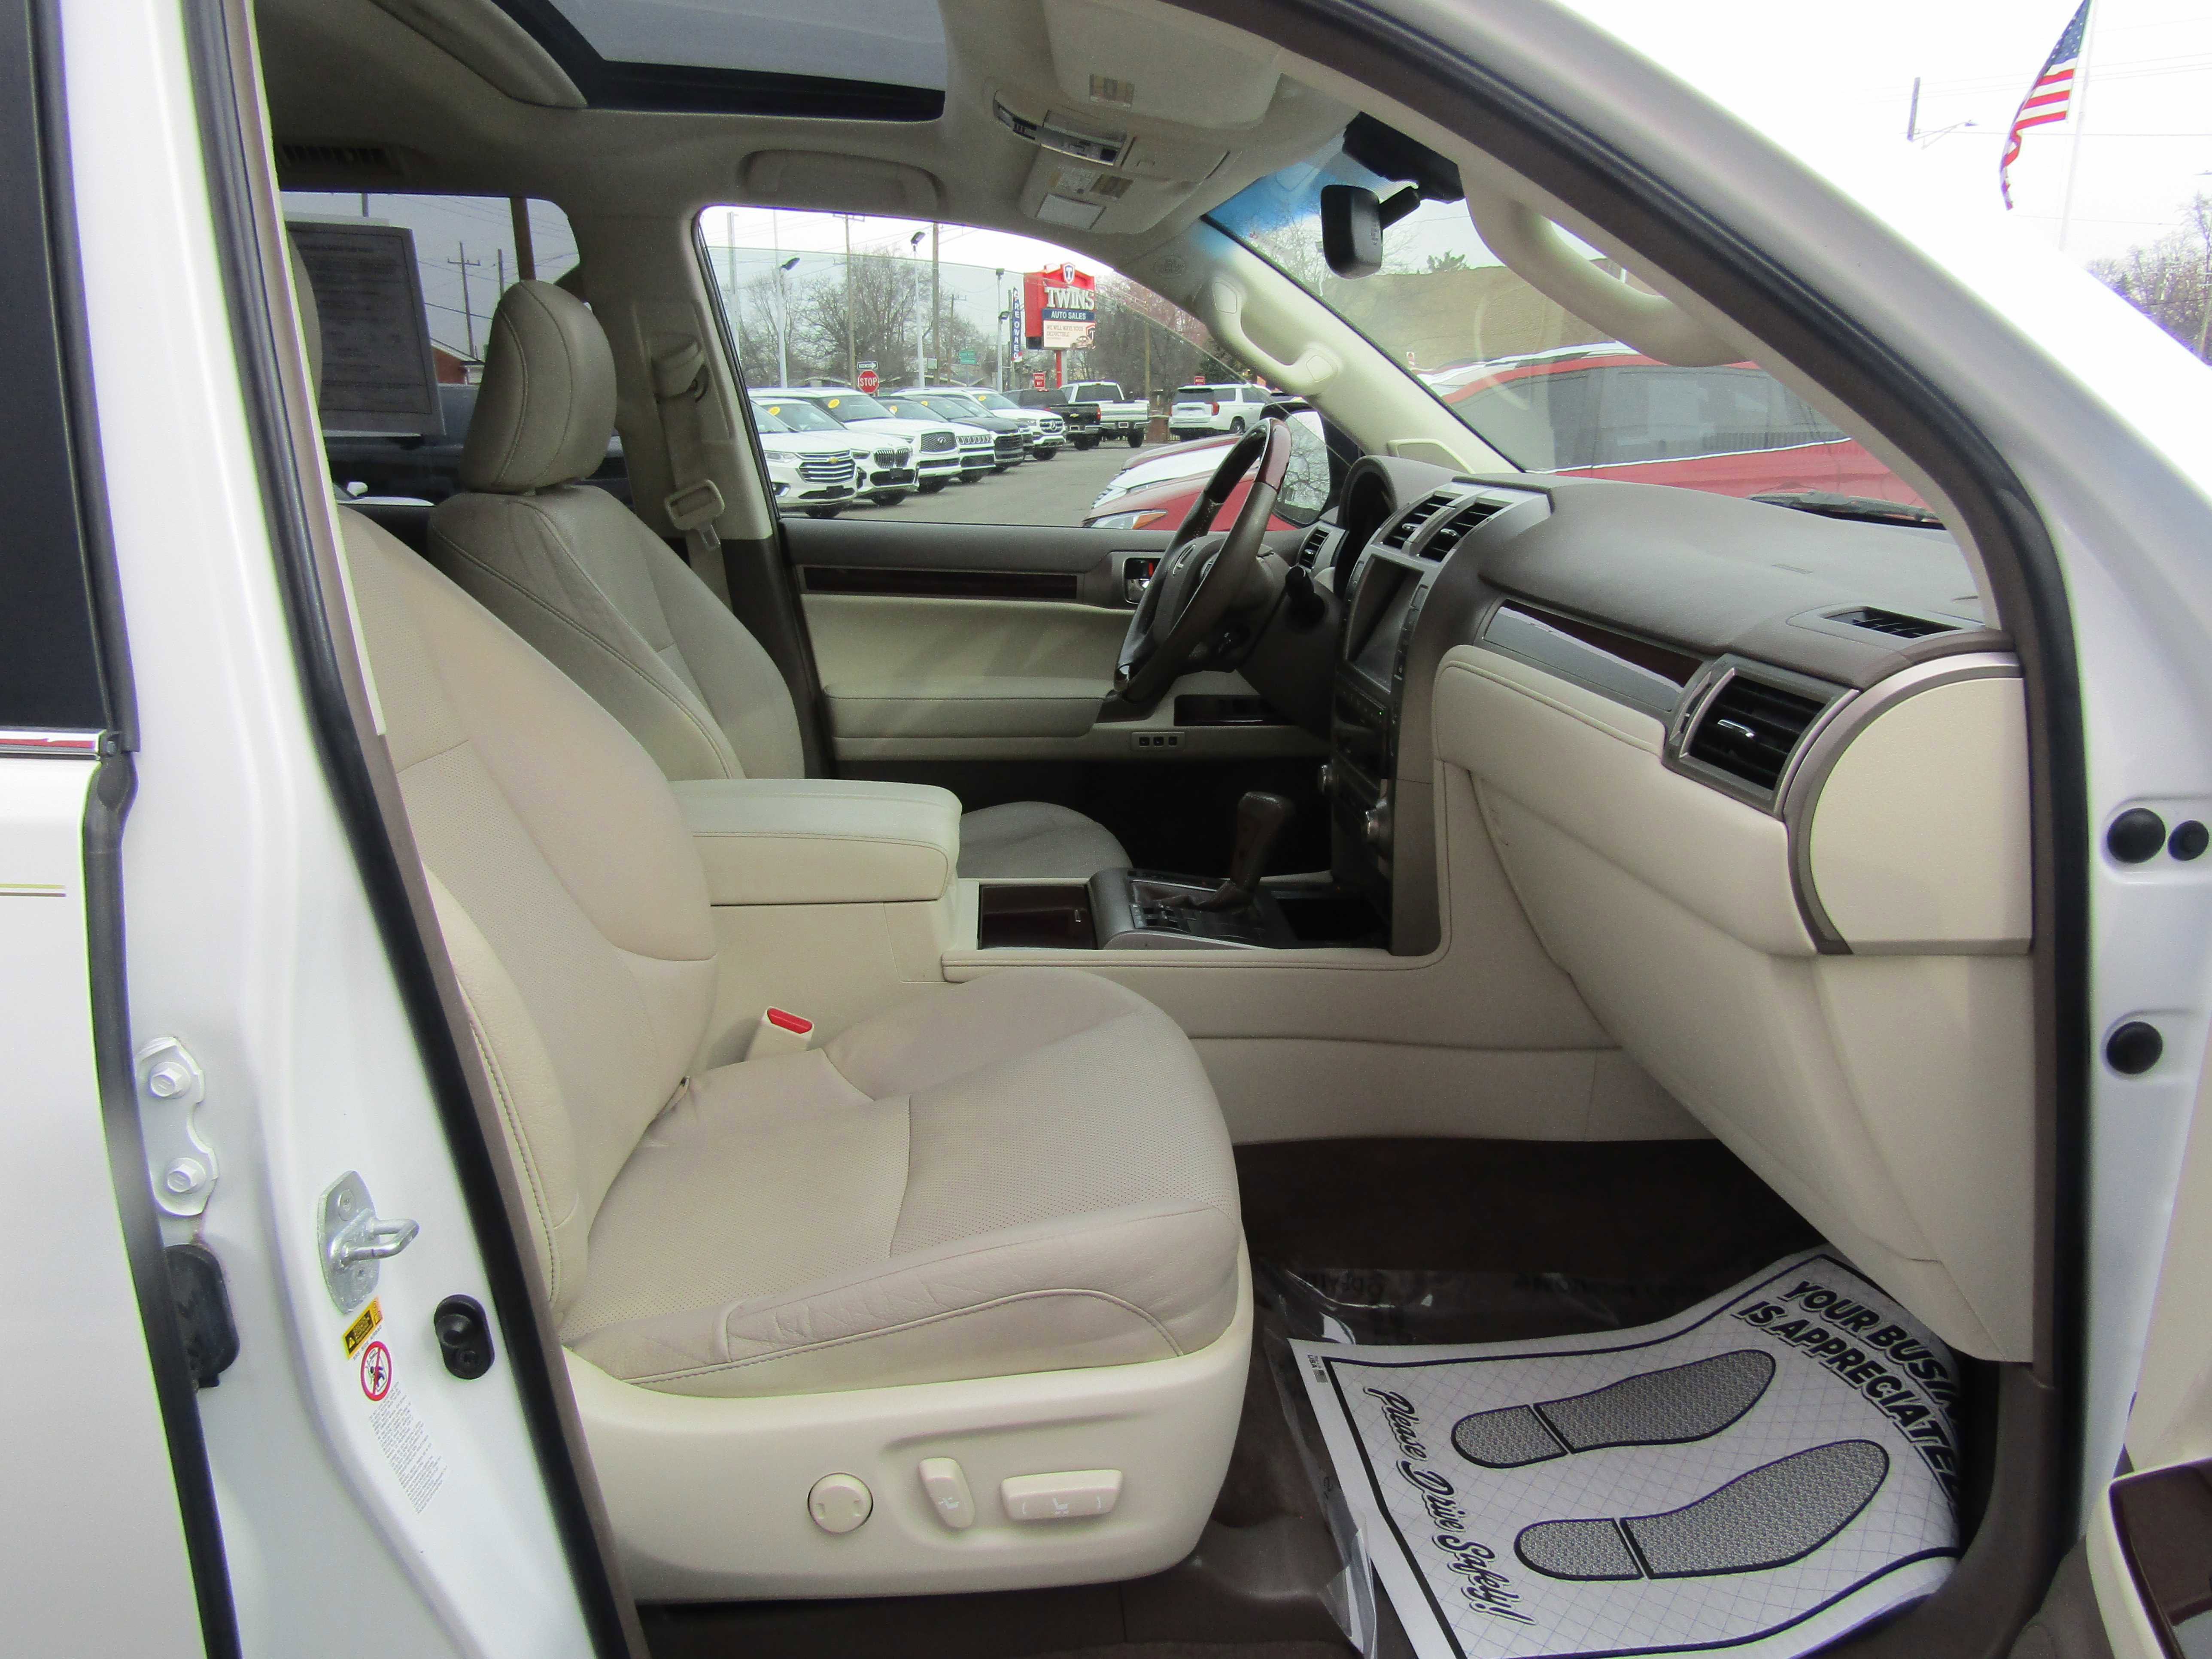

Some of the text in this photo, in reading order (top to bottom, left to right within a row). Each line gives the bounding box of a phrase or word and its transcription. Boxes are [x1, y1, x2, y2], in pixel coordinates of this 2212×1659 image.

[1066, 267, 1072, 281] T
[1044, 286, 1095, 310] TWINS
[1068, 312, 1086, 320] SALES
[860, 377, 877, 386] STOP
[1731, 1300, 1789, 1326] IS
[1777, 1281, 1880, 1338] YOUR
[1363, 1387, 1538, 1626] Please Drive Safely!
